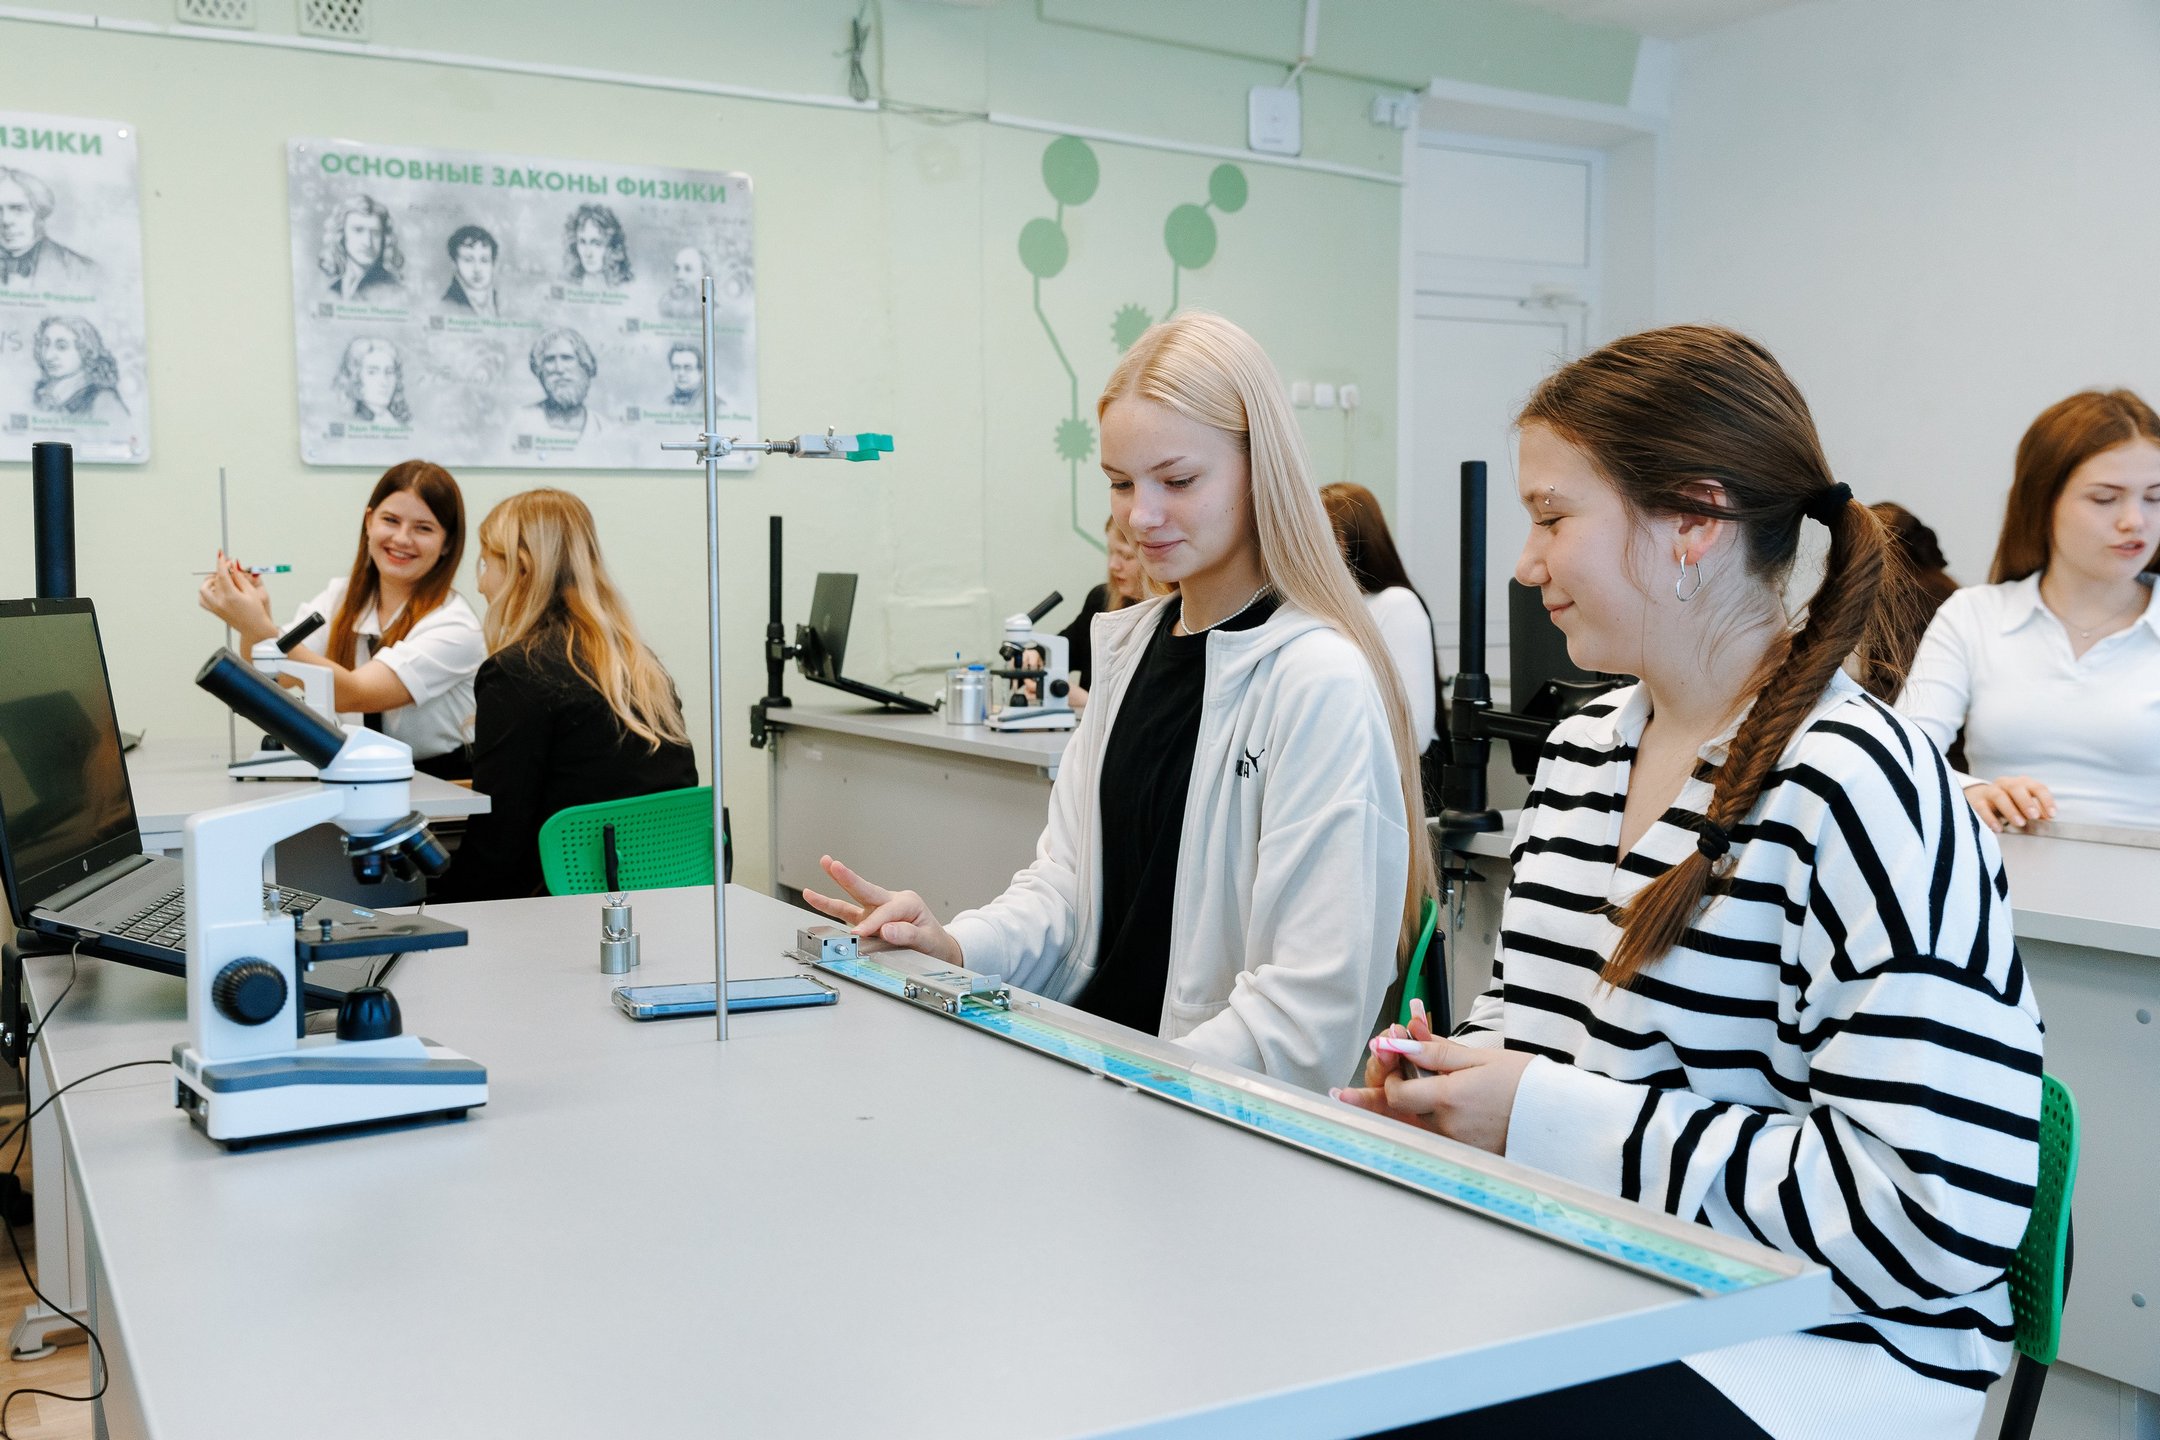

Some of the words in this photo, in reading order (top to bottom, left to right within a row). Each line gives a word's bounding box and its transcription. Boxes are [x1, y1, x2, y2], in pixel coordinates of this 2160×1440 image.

[320, 152, 483, 185] ОСНОВНЫЕ
[492, 166, 607, 195] ЗАКОНЫ
[616, 176, 727, 203] ФИЗИКИ
